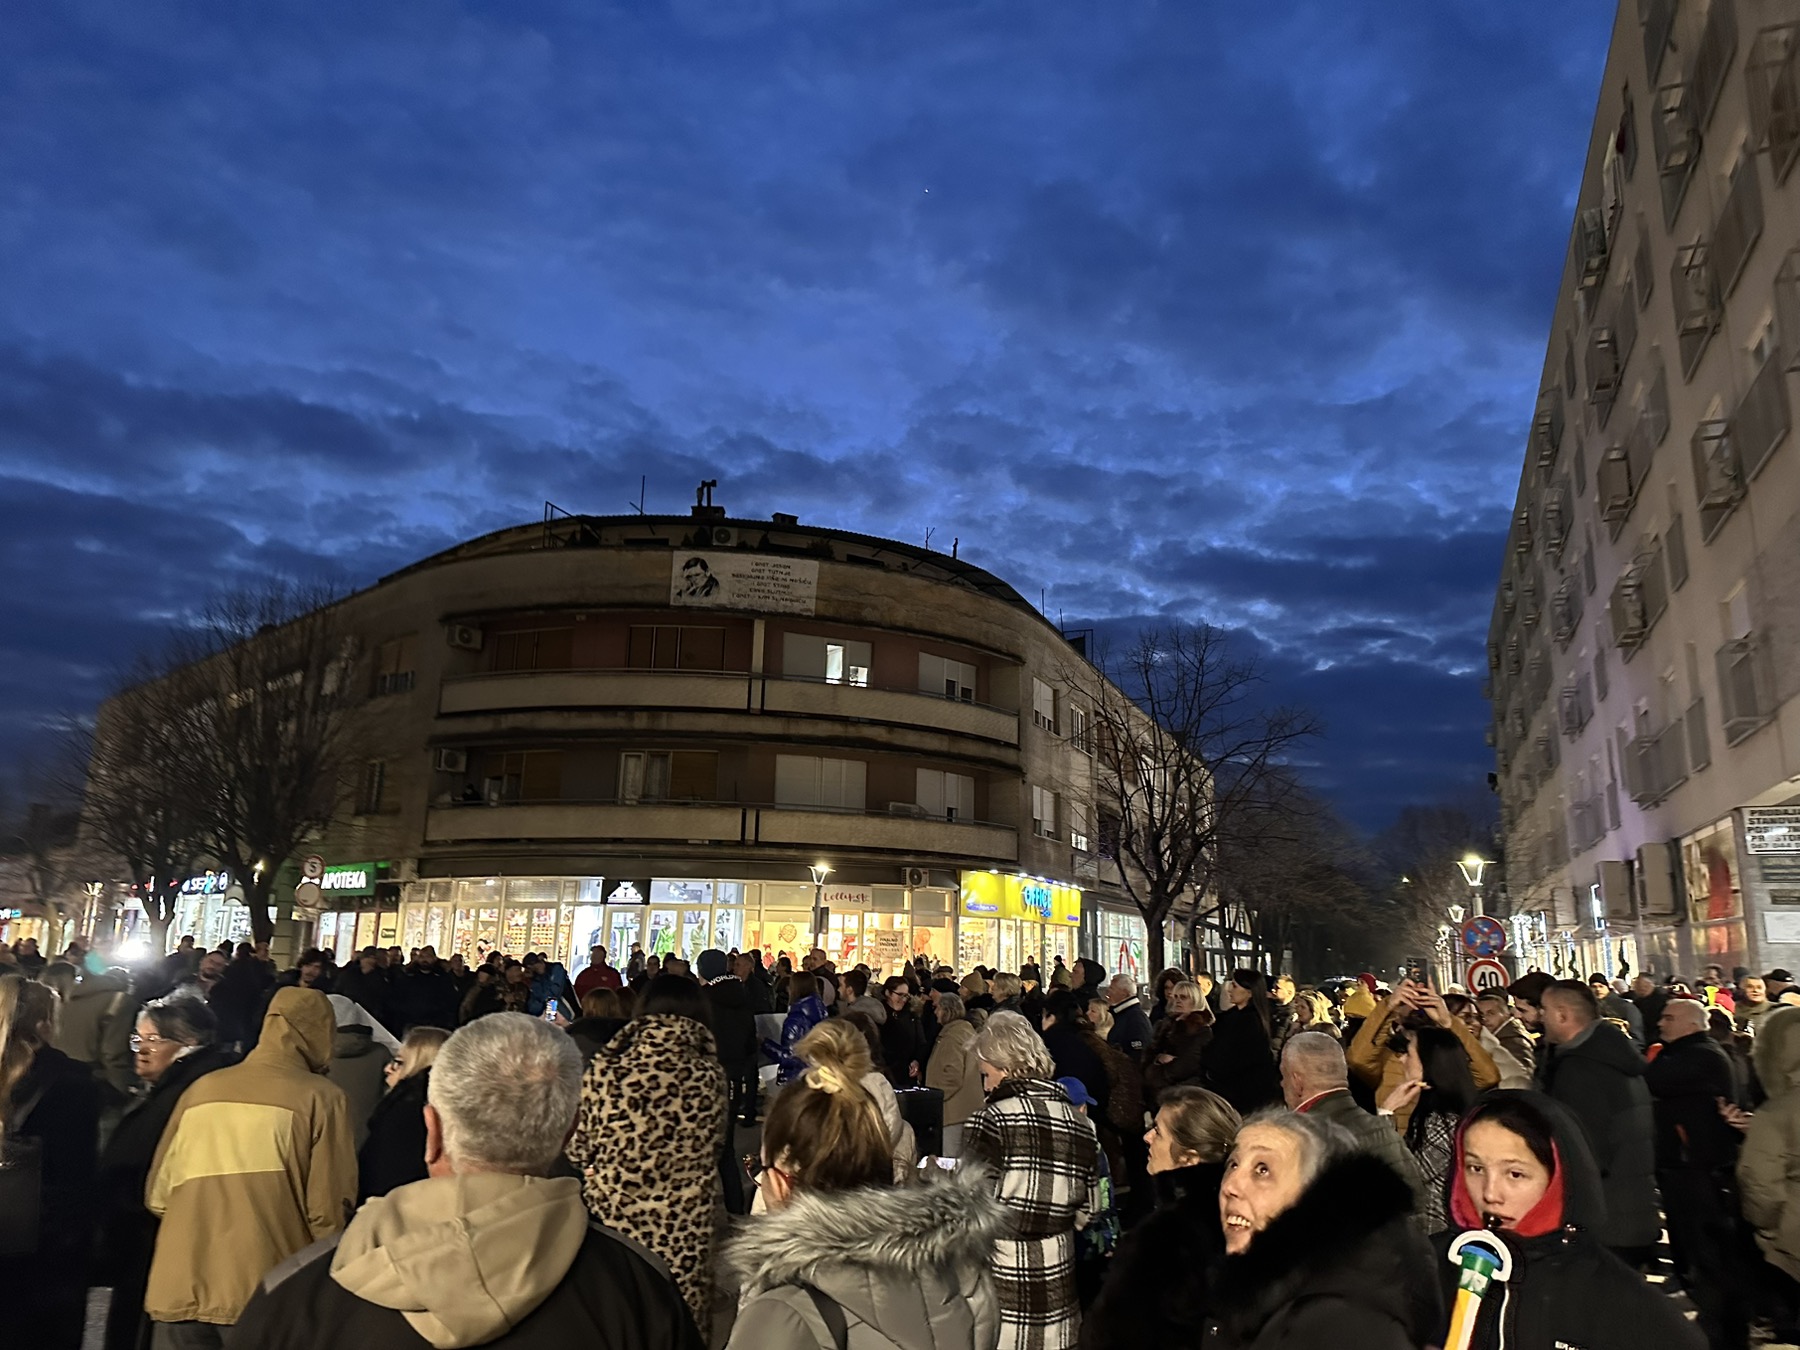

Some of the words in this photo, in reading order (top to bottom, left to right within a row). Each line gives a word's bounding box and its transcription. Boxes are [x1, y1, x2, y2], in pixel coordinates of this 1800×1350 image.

[321, 871, 366, 889] APOTEKA
[1025, 886, 1052, 908] OFFICE
[1478, 971, 1499, 988] 40
